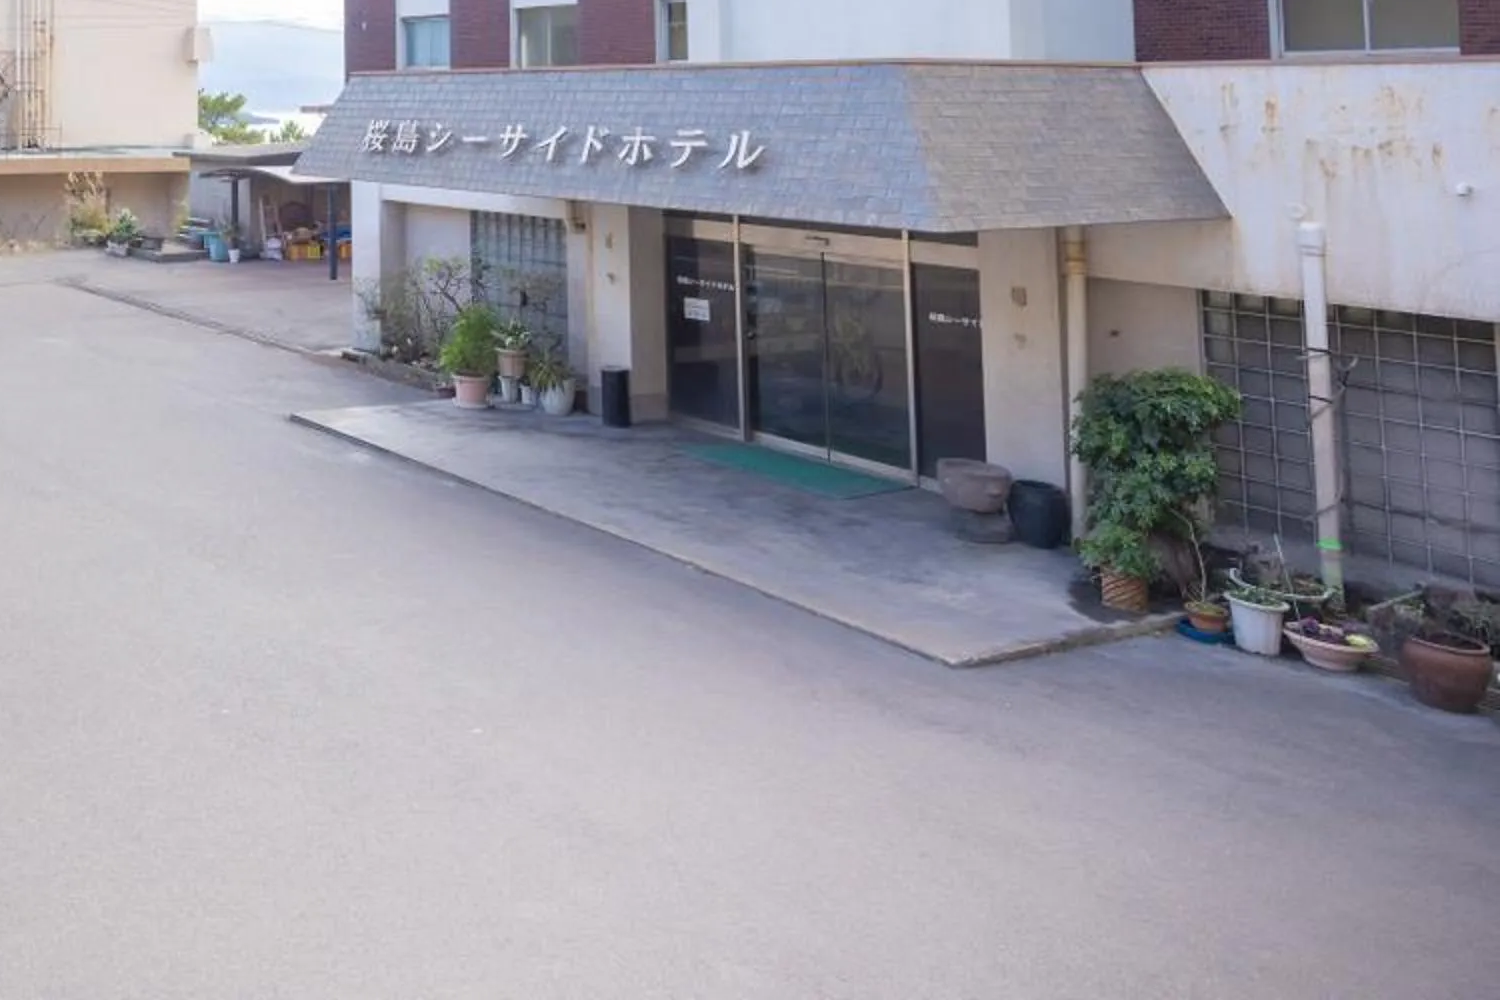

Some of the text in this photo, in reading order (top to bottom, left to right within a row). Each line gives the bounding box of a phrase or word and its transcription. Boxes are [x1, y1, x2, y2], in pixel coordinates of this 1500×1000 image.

[363, 119, 766, 170] 桜島シーサイドホテル
